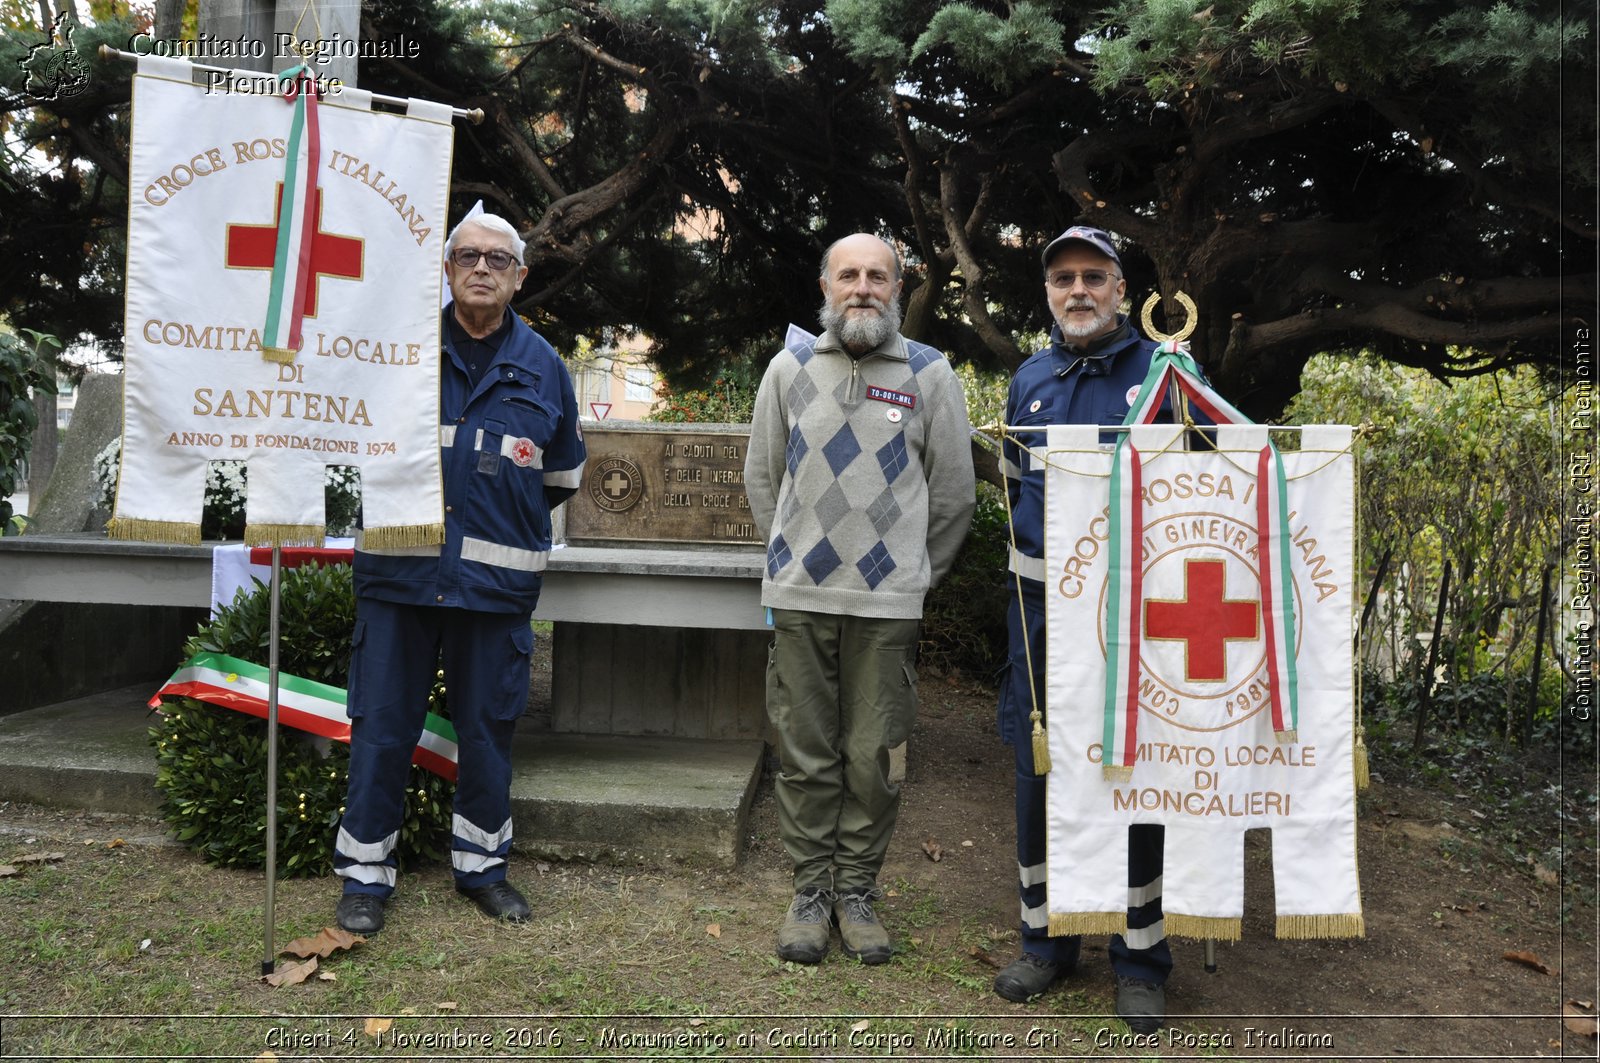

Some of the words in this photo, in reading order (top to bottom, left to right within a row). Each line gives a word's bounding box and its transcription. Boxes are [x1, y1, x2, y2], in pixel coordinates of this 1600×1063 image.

[144, 148, 227, 207] CROCE
[232, 138, 286, 165] ROS
[328, 151, 432, 247] ITALIANA
[143, 319, 304, 353] COMITA
[316, 333, 421, 365] LOCALE
[277, 362, 304, 383] DI
[193, 388, 373, 427] SANTENA
[167, 432, 223, 447] ANNO
[230, 434, 248, 448] DI
[255, 434, 358, 454] FONDAZIONE
[366, 442, 396, 456] 1974
[665, 444, 674, 457] AI
[682, 445, 713, 458] CADUTI
[723, 446, 738, 459] DEL
[664, 469, 670, 481] E
[676, 469, 701, 482] DELLE
[710, 470, 745, 484] INFERMI
[664, 493, 691, 507] DELLA
[702, 494, 729, 508] CROCE
[726, 524, 753, 537] MILITI
[1087, 743, 1215, 767] CMITATO
[1225, 745, 1316, 768] LOCALE
[1194, 770, 1219, 790] DI
[1113, 788, 1290, 816] MONCALIERI
